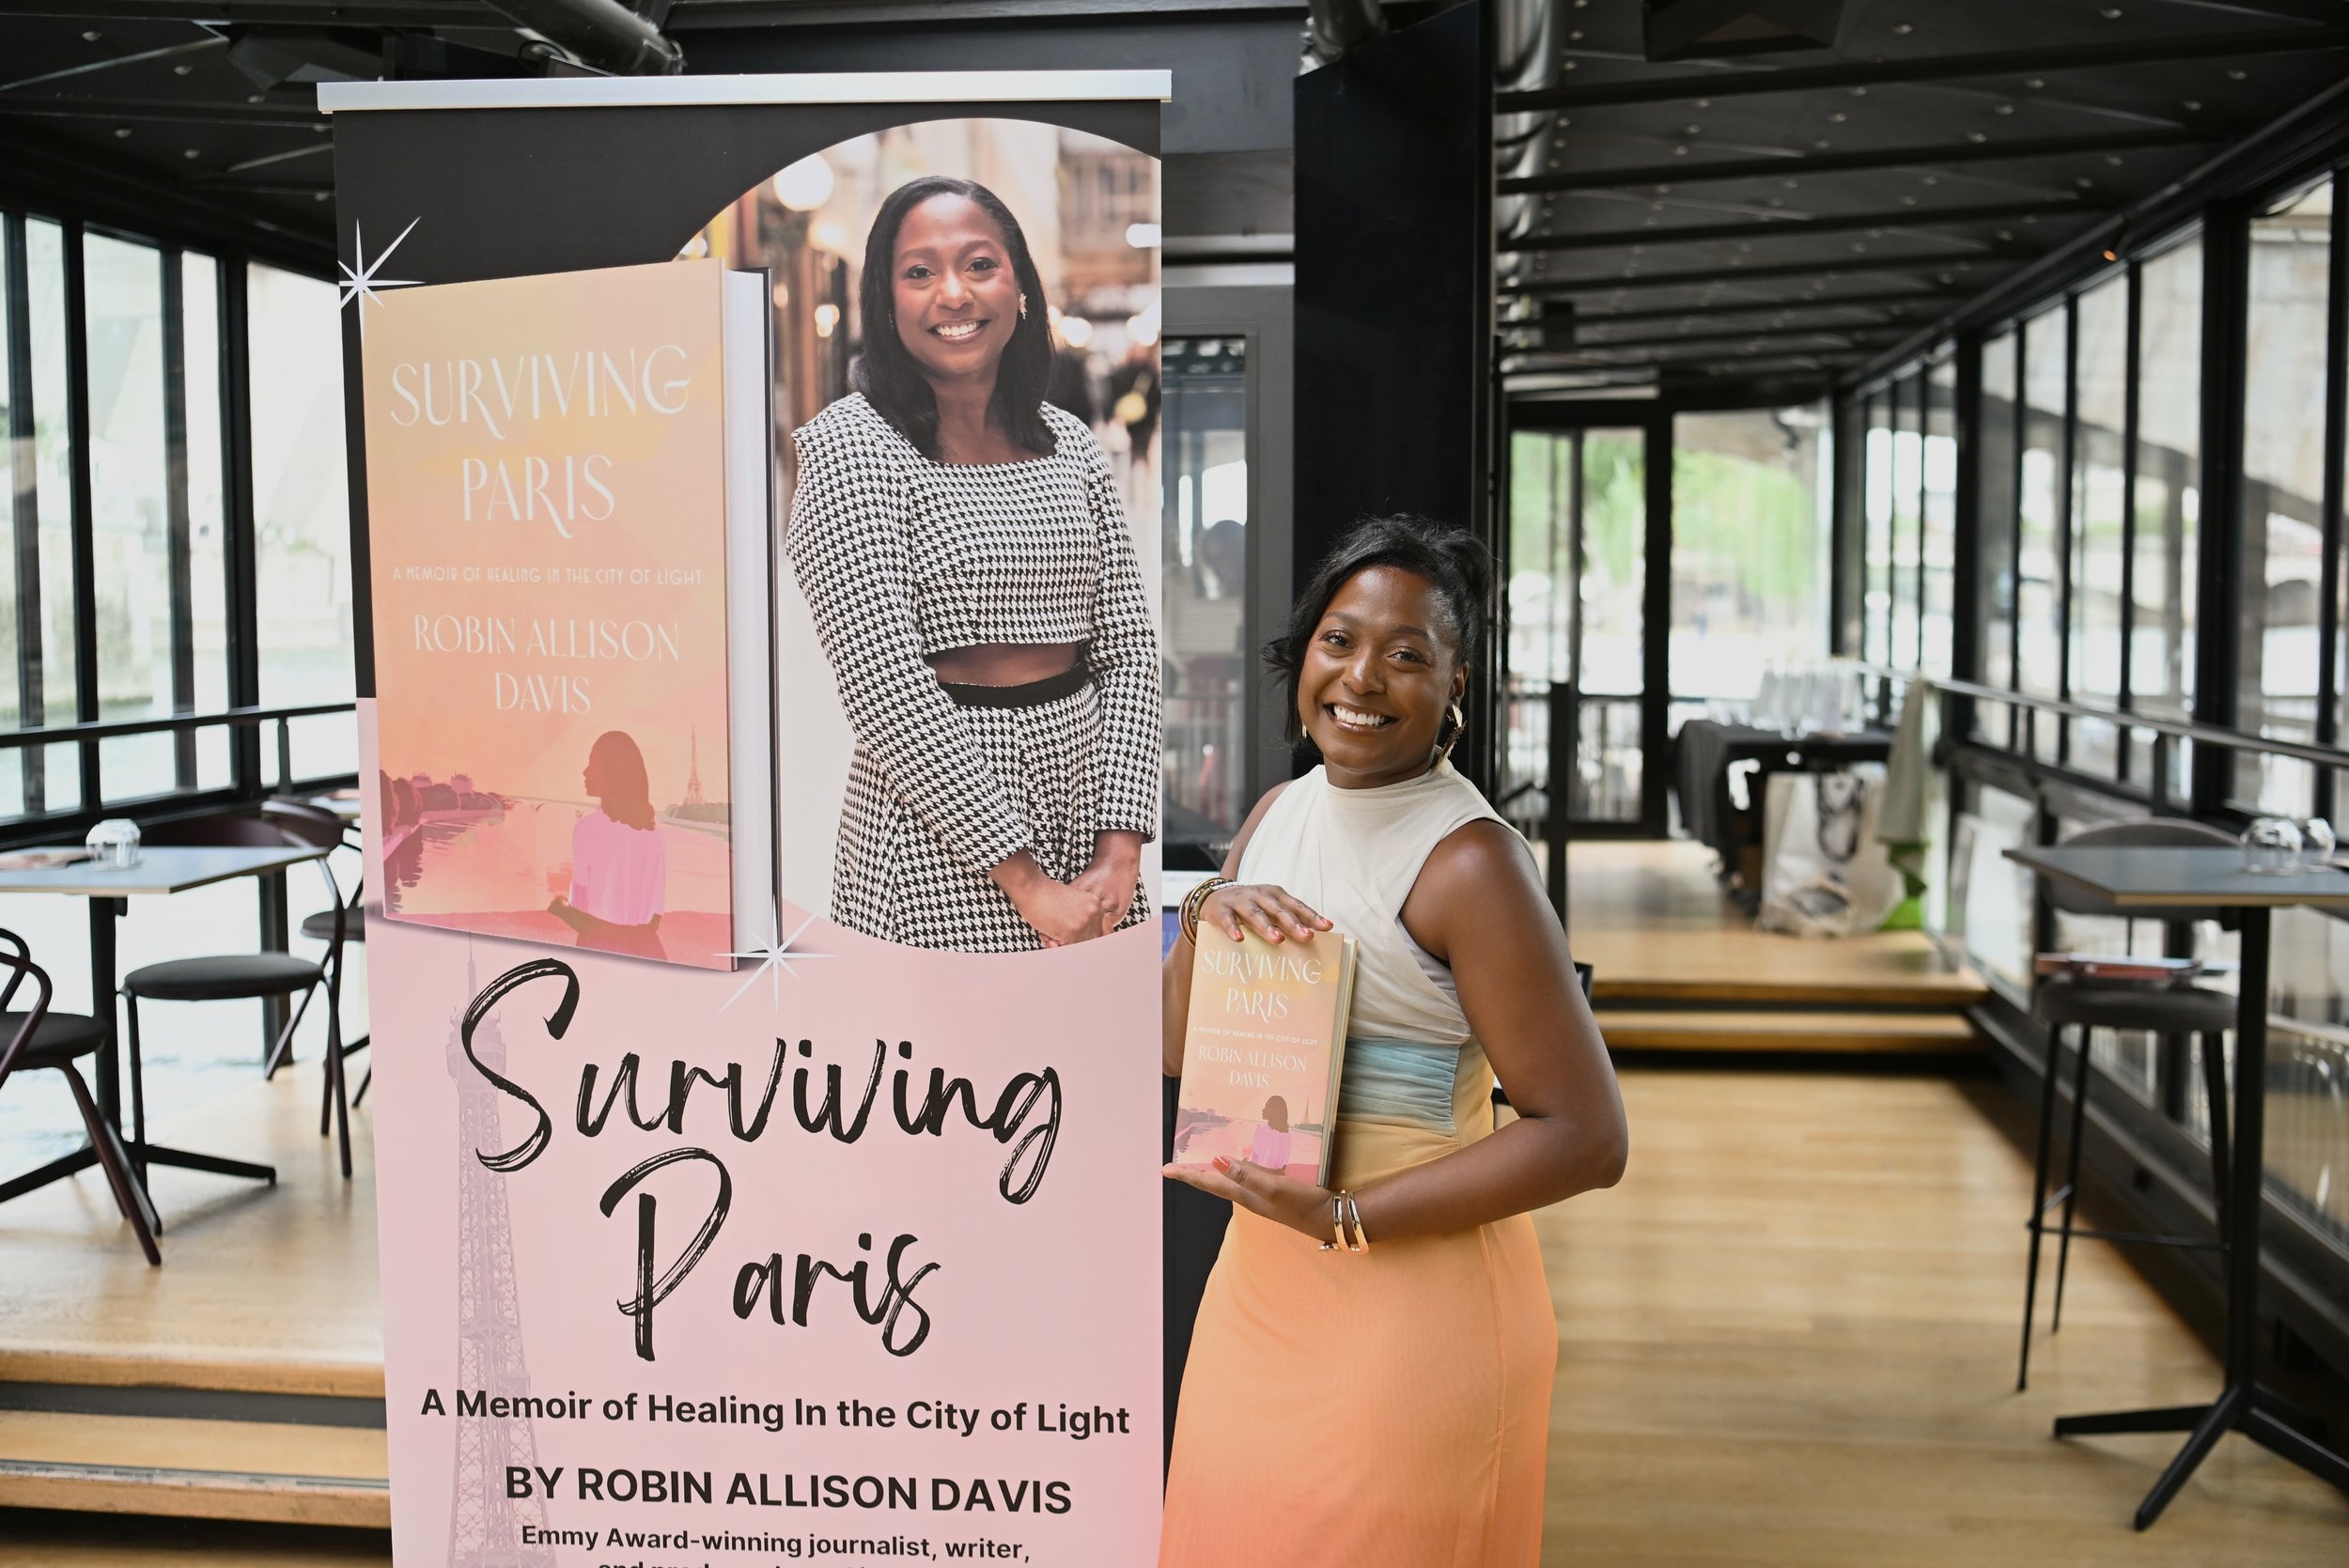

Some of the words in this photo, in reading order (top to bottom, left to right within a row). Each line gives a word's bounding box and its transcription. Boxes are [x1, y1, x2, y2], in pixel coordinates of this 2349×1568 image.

[390, 344, 692, 441] SURVIVING
[461, 453, 616, 539] PARIS
[392, 567, 402, 581] A
[406, 566, 458, 582] MEMOIR
[462, 567, 482, 582] OF
[487, 567, 541, 583] HEALING
[547, 567, 560, 583] IN
[566, 567, 590, 584] THE
[596, 567, 624, 584] CITY
[630, 568, 651, 585] OF
[657, 568, 703, 586] LIGHT
[413, 613, 516, 655] ROBIN
[525, 617, 680, 662] ALLISON
[494, 672, 592, 716] DAVIS
[1201, 949, 1322, 985] SURVIVING
[1225, 987, 1288, 1024] PARIS
[1198, 1044, 1242, 1065] ROBIN
[1245, 1050, 1308, 1072] ALLISON
[1276, 1034, 1290, 1043] CITY
[460, 957, 1063, 1205] Surviving
[1229, 1069, 1270, 1089] DAVIS
[599, 1146, 941, 1362] Paris
[421, 1389, 446, 1416] A
[456, 1389, 593, 1420] Memoir
[602, 1392, 638, 1421] of
[648, 1394, 784, 1433] Healing
[795, 1398, 827, 1426] In
[837, 1399, 896, 1428] the
[907, 1400, 980, 1437] City
[990, 1402, 1028, 1431] of
[1036, 1402, 1130, 1440] Light
[506, 1466, 564, 1499] BY
[578, 1467, 712, 1504] ROBIN
[725, 1472, 917, 1510] ALLISON
[931, 1478, 1072, 1514] DAVIS
[521, 1525, 599, 1551] Emmy
[606, 1528, 801, 1558] Award-winning
[807, 1533, 937, 1561] journalist,
[944, 1537, 1030, 1563] writer,
